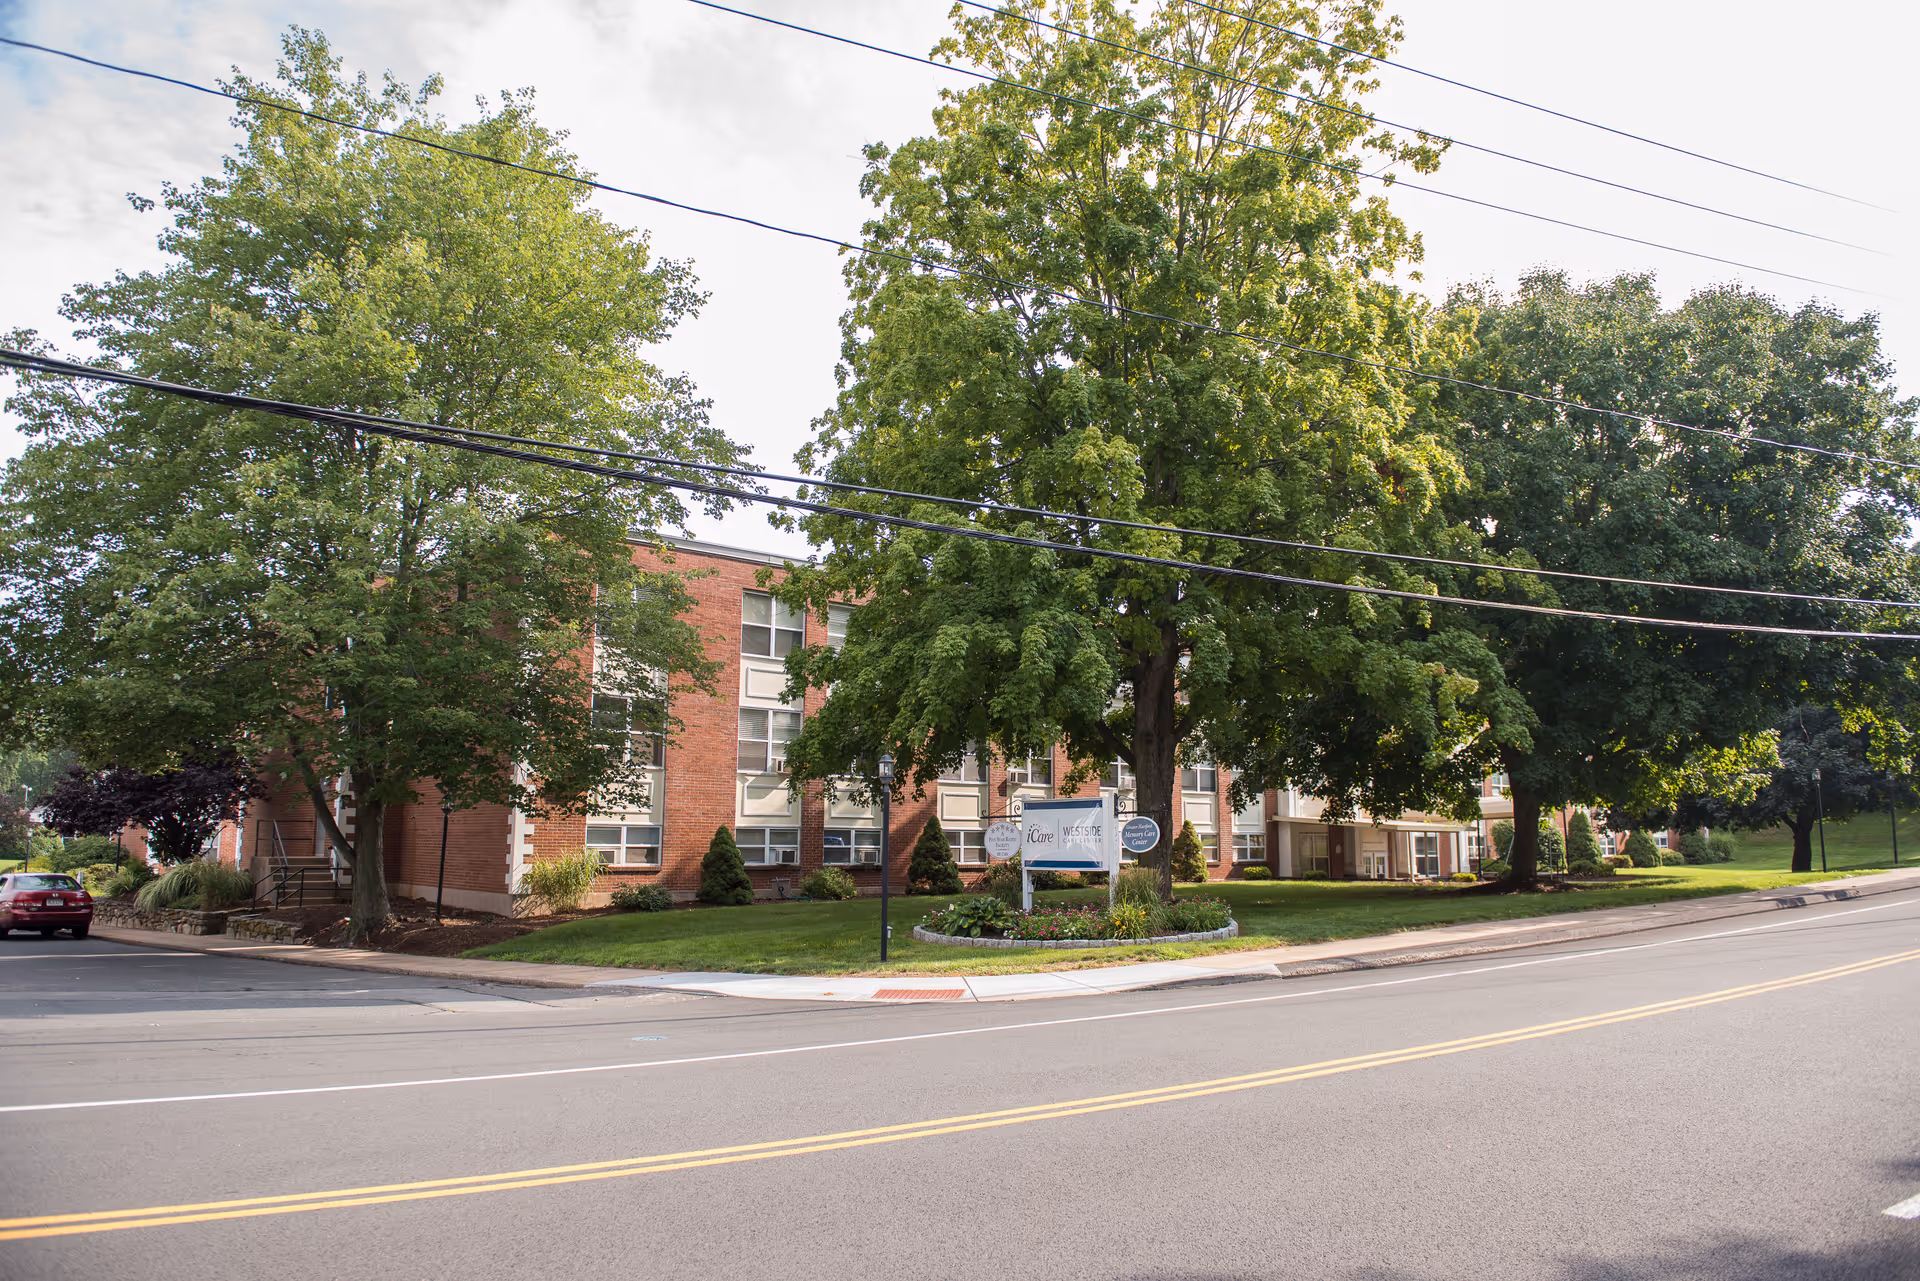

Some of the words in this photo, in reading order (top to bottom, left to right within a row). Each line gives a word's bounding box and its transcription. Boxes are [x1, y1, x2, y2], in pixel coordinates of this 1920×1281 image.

[1027, 828, 1054, 843] iCare
[1063, 826, 1101, 836] WESTSIDE
[1125, 831, 1143, 839] Memory
